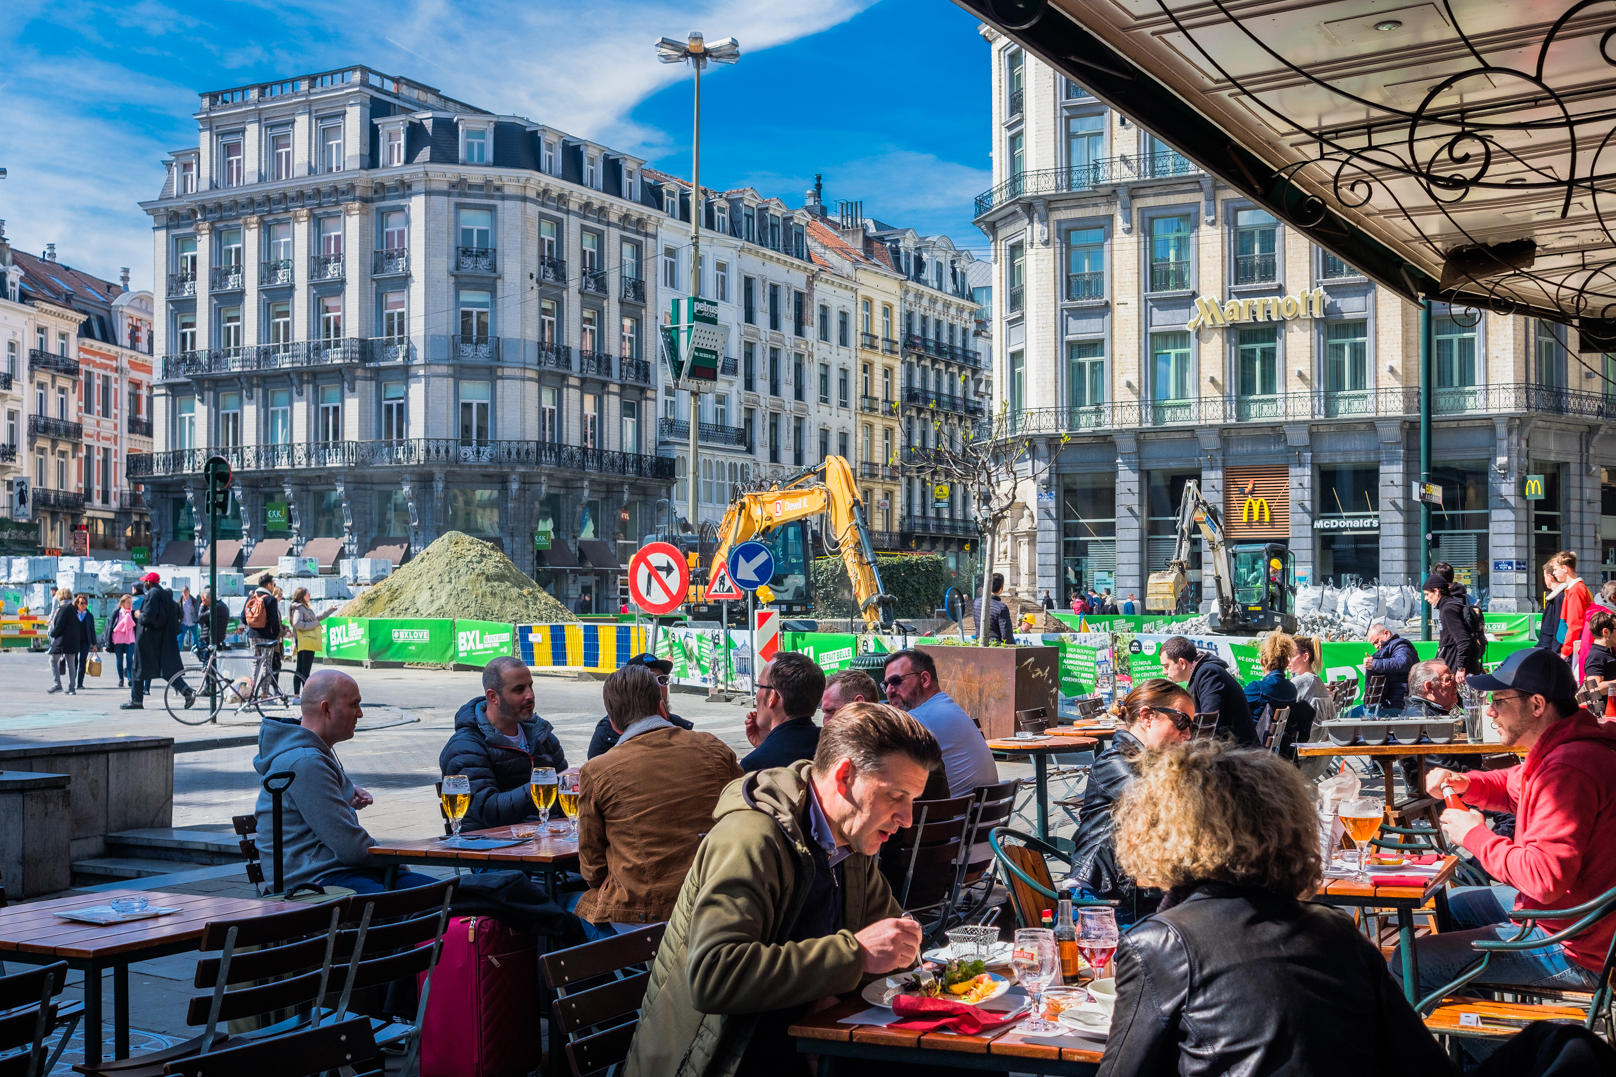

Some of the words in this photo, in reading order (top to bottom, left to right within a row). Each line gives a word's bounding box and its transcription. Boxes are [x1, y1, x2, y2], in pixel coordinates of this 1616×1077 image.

[694, 301, 718, 314] petrus
[1187, 287, 1326, 331] Marriott
[1313, 519, 1379, 528] McDonald's
[45, 549, 62, 557] KING
[330, 625, 349, 646] BXL
[458, 630, 484, 652] BXL
[820, 654, 826, 663] SE
[826, 652, 836, 662] FAIT
[836, 649, 851, 660] BELLE
